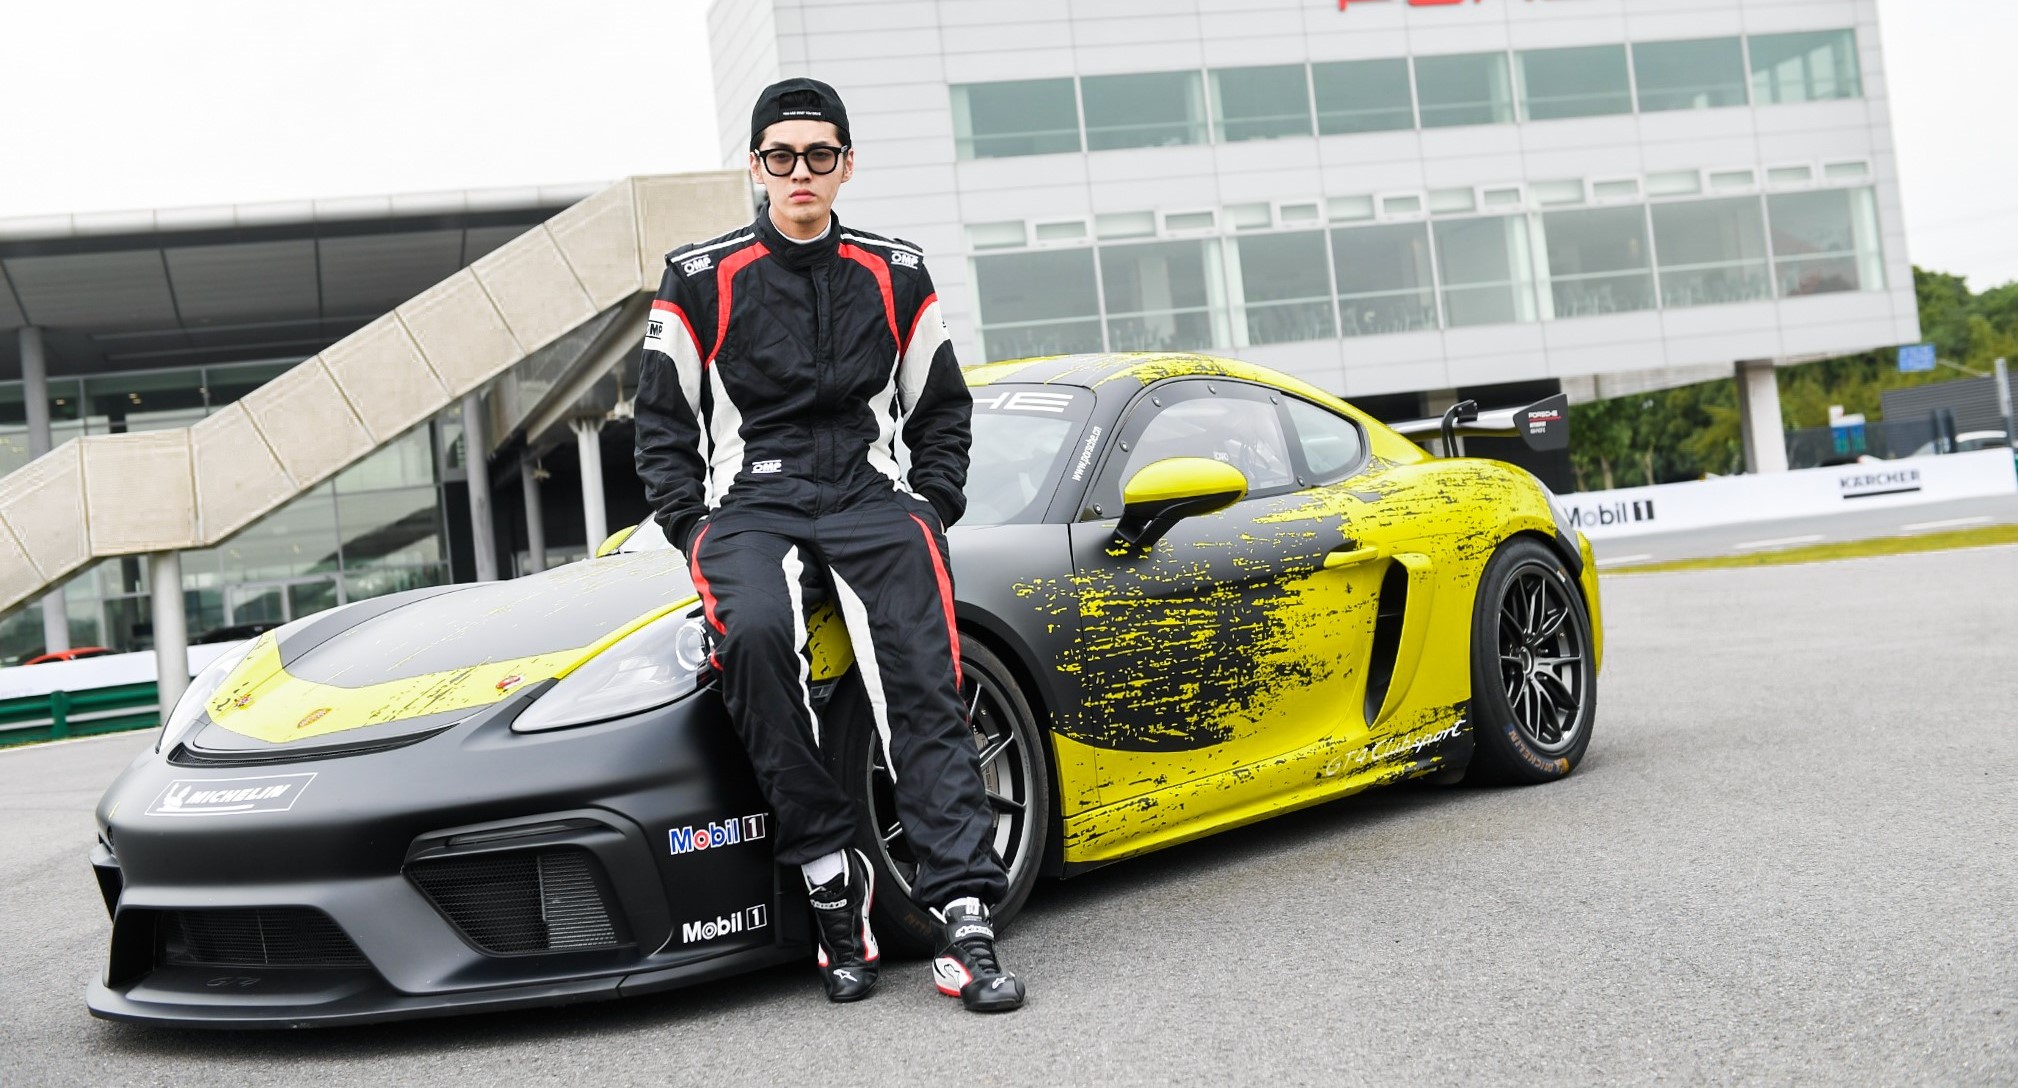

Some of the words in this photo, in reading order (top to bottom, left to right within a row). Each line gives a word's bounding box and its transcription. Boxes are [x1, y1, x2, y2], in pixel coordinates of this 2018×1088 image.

[684, 257, 711, 273] OMP
[891, 253, 919, 266] OMP
[1072, 425, 1102, 481] www.porsche.cn
[753, 462, 782, 472] OMP
[1564, 502, 1627, 526] Mobil
[1326, 747, 1369, 776] GT4
[1371, 719, 1467, 761] Clubsport
[185, 784, 292, 805] MICHELIN
[669, 818, 740, 855] Mobil
[682, 911, 742, 944] Mobil
